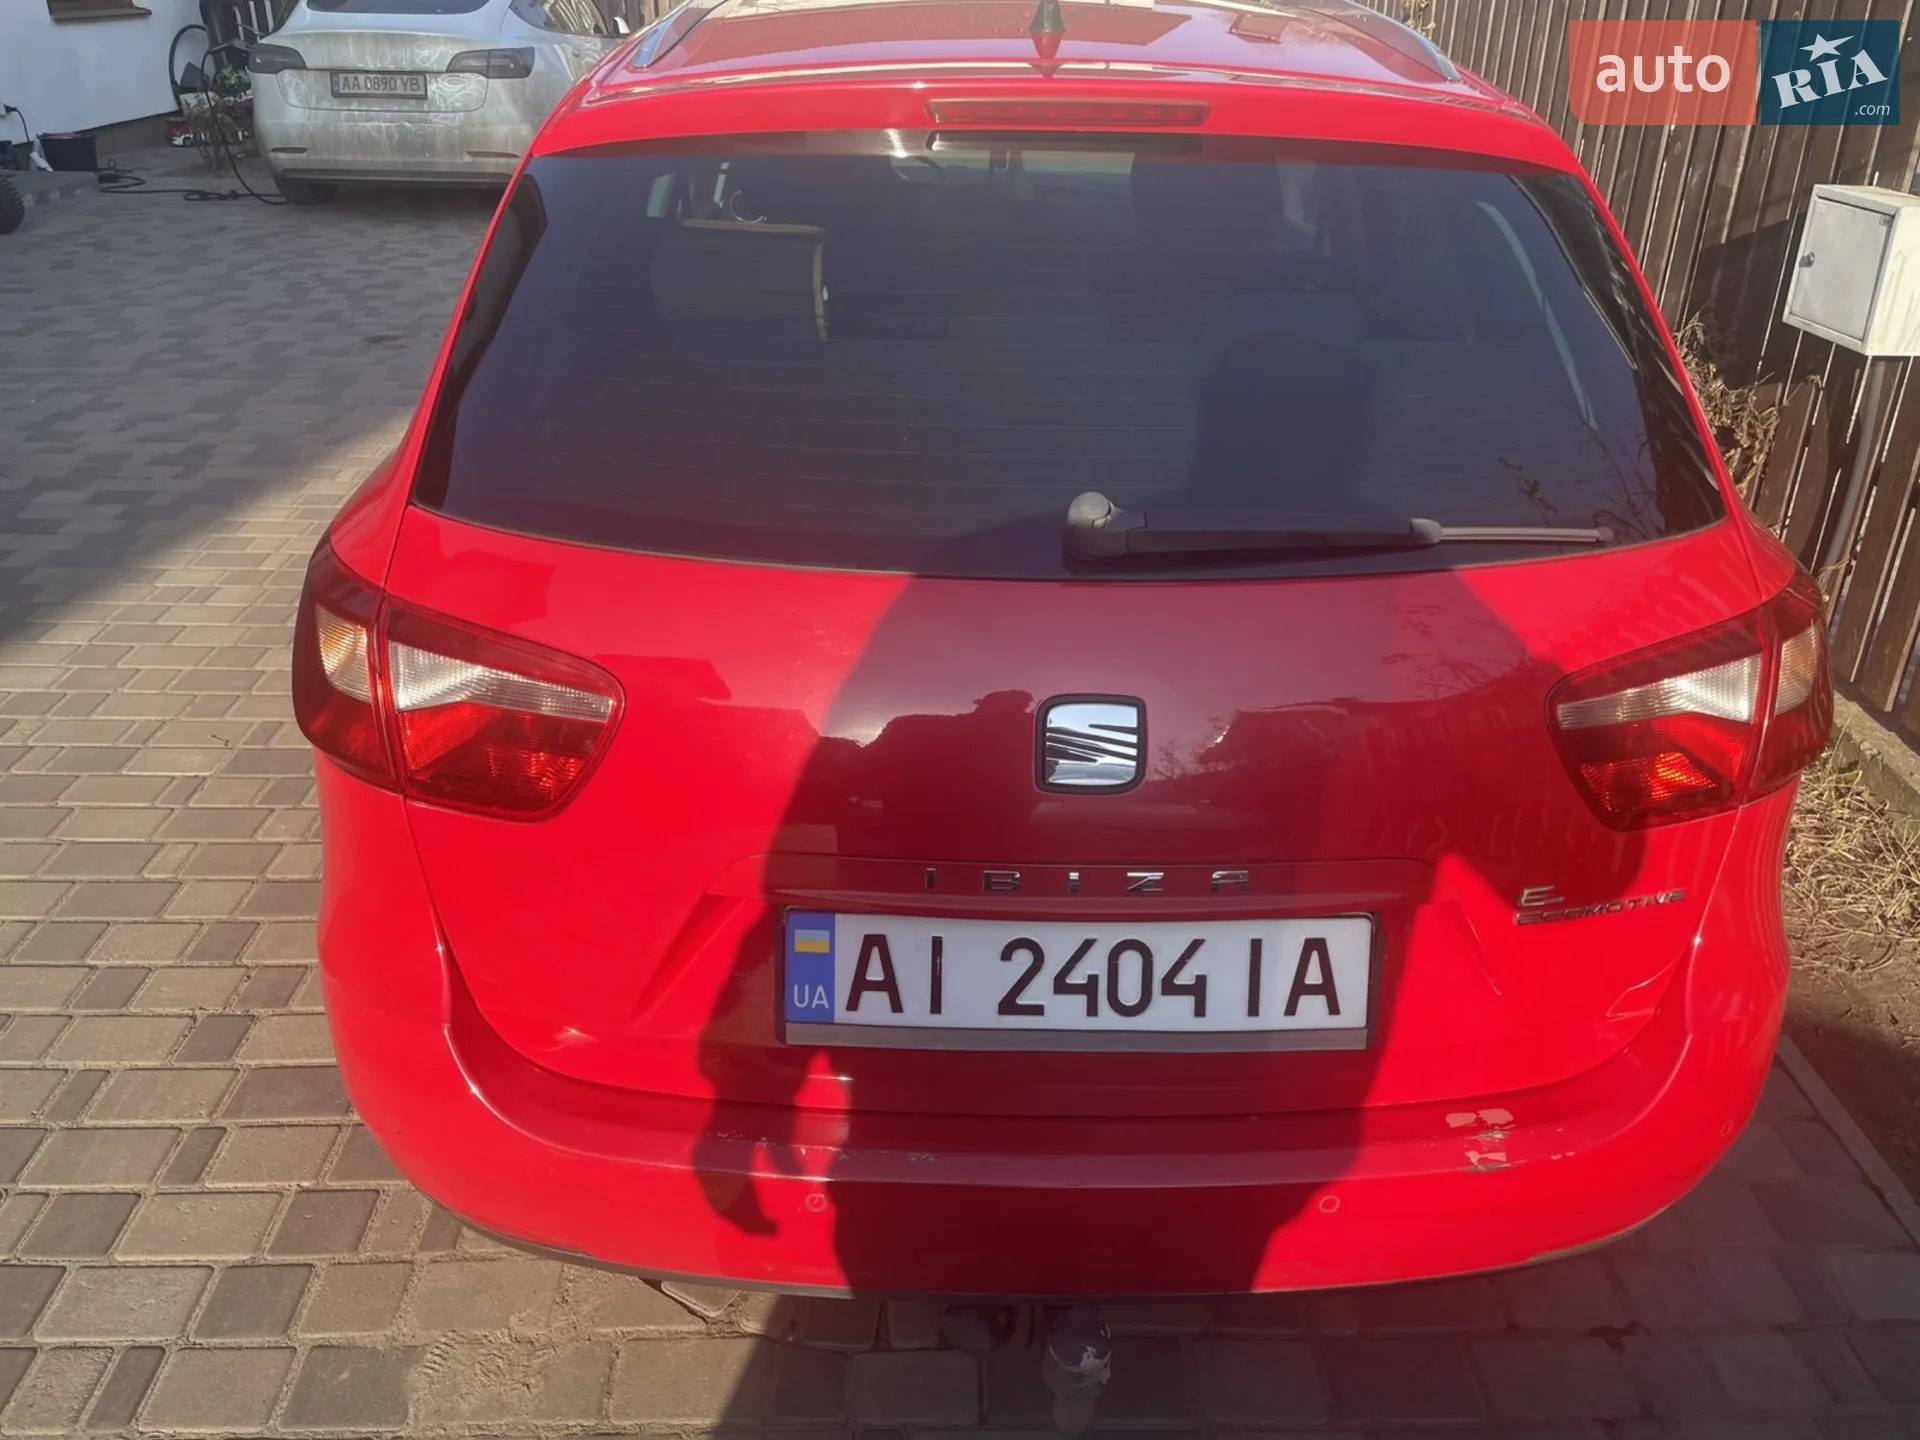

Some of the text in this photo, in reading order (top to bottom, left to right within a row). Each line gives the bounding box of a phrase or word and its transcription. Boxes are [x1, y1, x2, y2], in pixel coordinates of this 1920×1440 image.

[342, 75, 360, 91] AA
[364, 76, 397, 91] 0890
[924, 867, 1249, 893] IBIZA
[845, 933, 1341, 1018] AI 2404 IA
[793, 984, 829, 1010] UA
